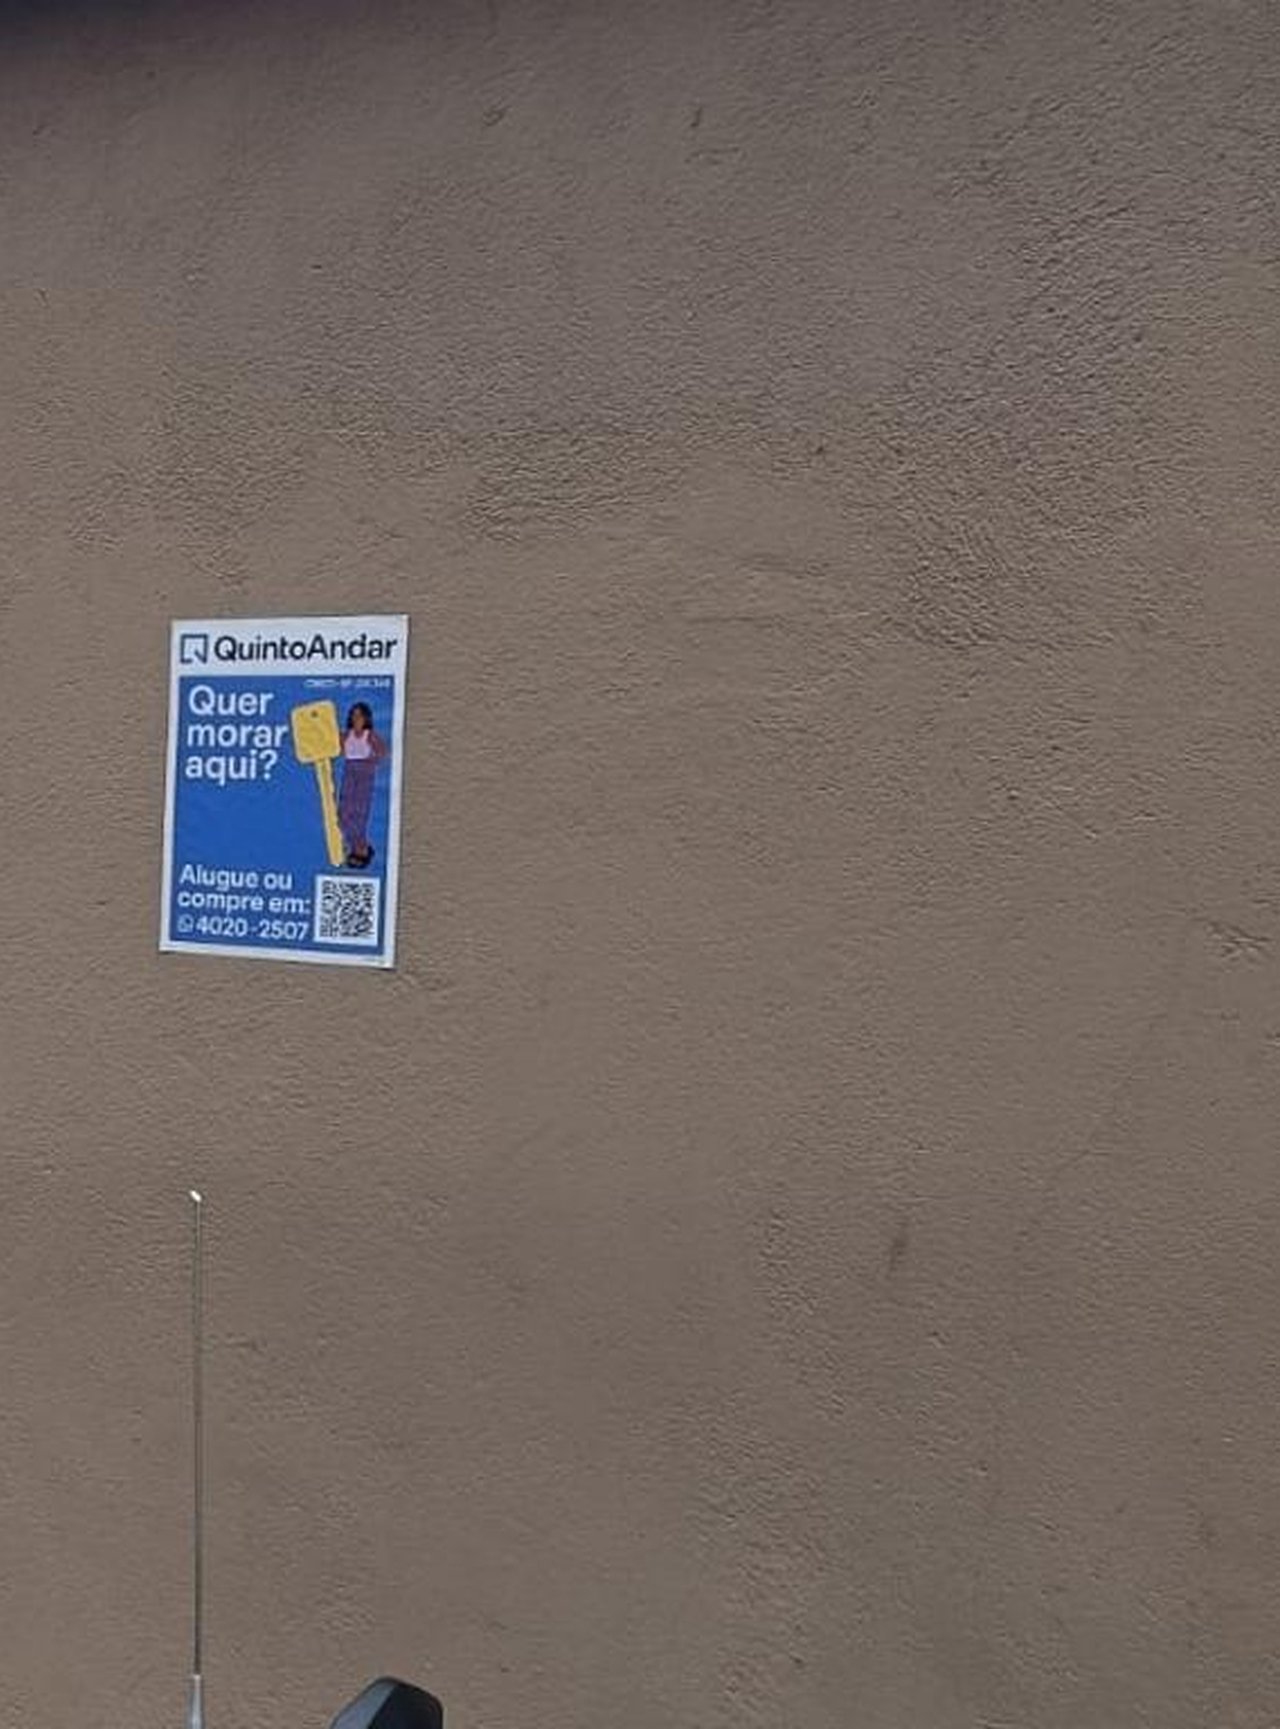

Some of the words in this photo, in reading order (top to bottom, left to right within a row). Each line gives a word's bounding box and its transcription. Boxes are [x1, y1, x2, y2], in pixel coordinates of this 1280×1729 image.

[213, 632, 398, 661] QuintoAndar
[188, 684, 274, 718] Quer
[186, 723, 288, 748] morar
[184, 749, 278, 786] aqui?
[179, 863, 260, 892] Alugue
[263, 872, 293, 890] ou
[177, 891, 264, 914] compre
[268, 896, 312, 915] em:
